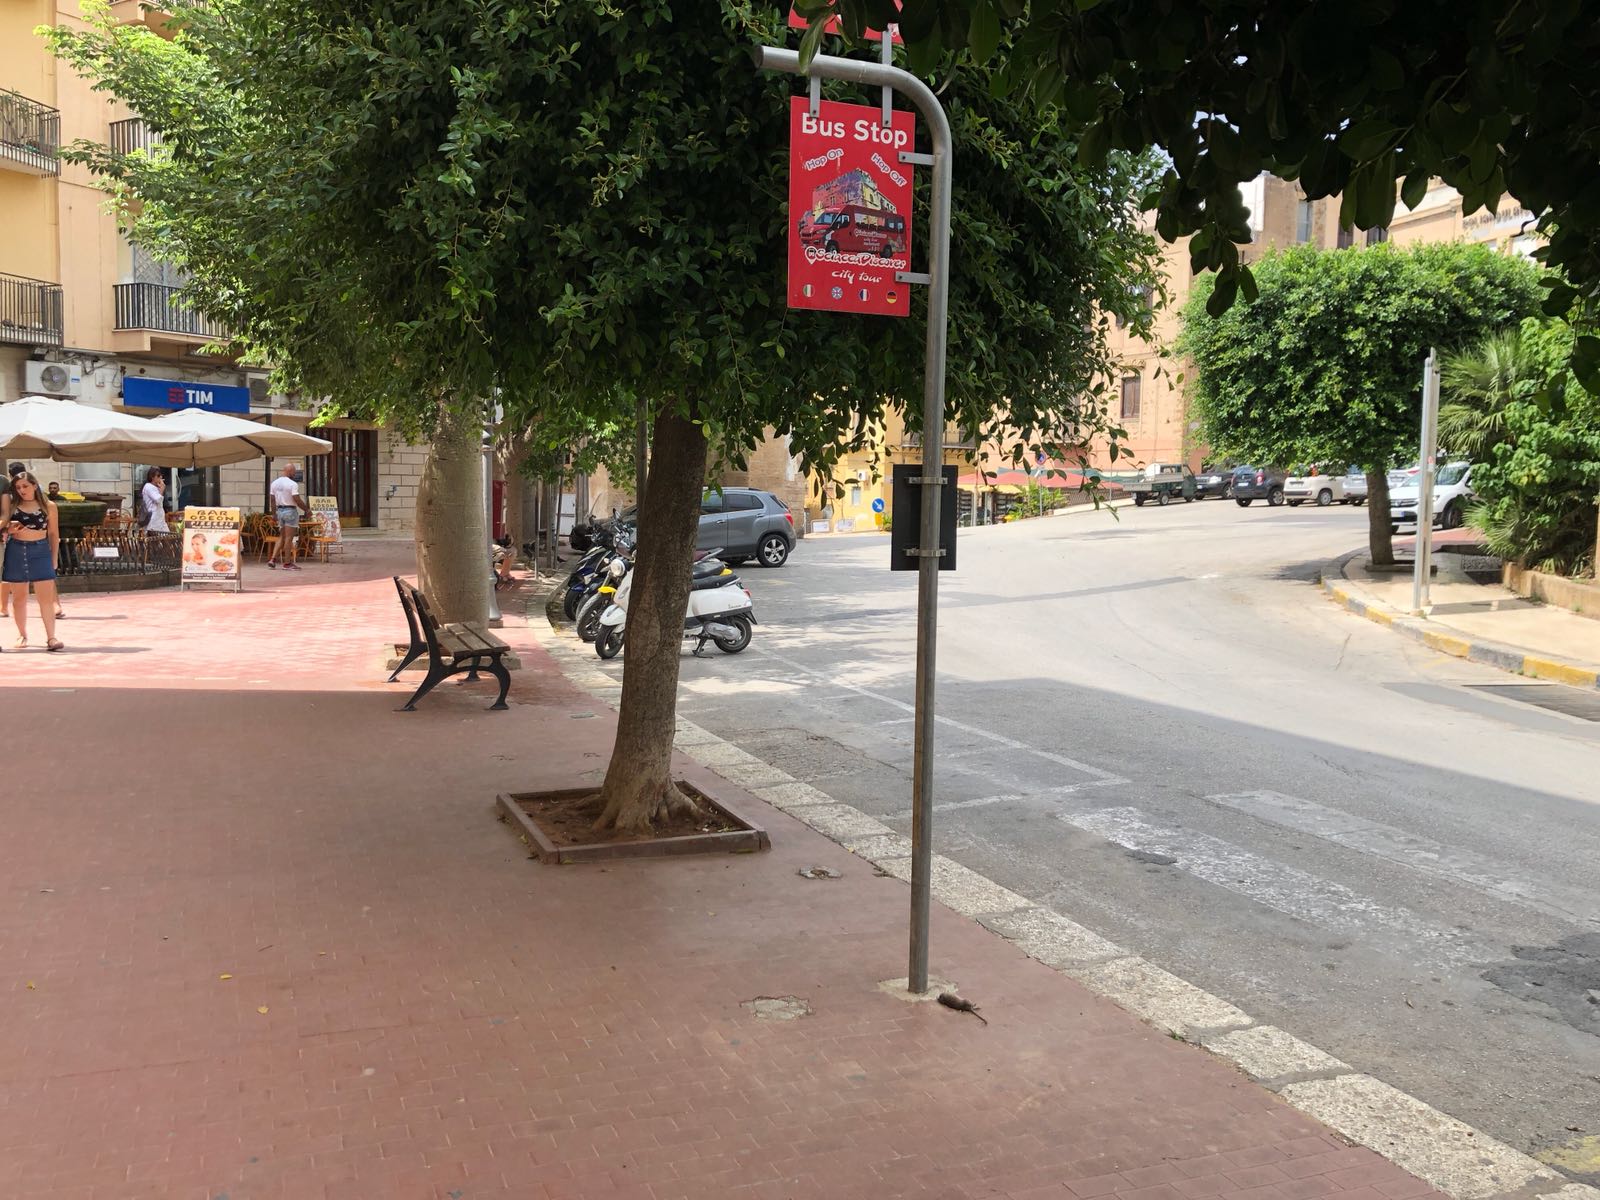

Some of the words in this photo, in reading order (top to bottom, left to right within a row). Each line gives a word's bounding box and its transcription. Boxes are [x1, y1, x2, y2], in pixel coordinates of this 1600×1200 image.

[802, 112, 846, 139] Bus
[853, 119, 908, 149] Stop
[806, 155, 828, 171] Hop
[827, 148, 844, 161] On
[871, 153, 890, 174] Hop
[889, 170, 907, 187] Off
[831, 269, 855, 285] city
[858, 271, 882, 283] tour
[186, 389, 213, 405] TIM
